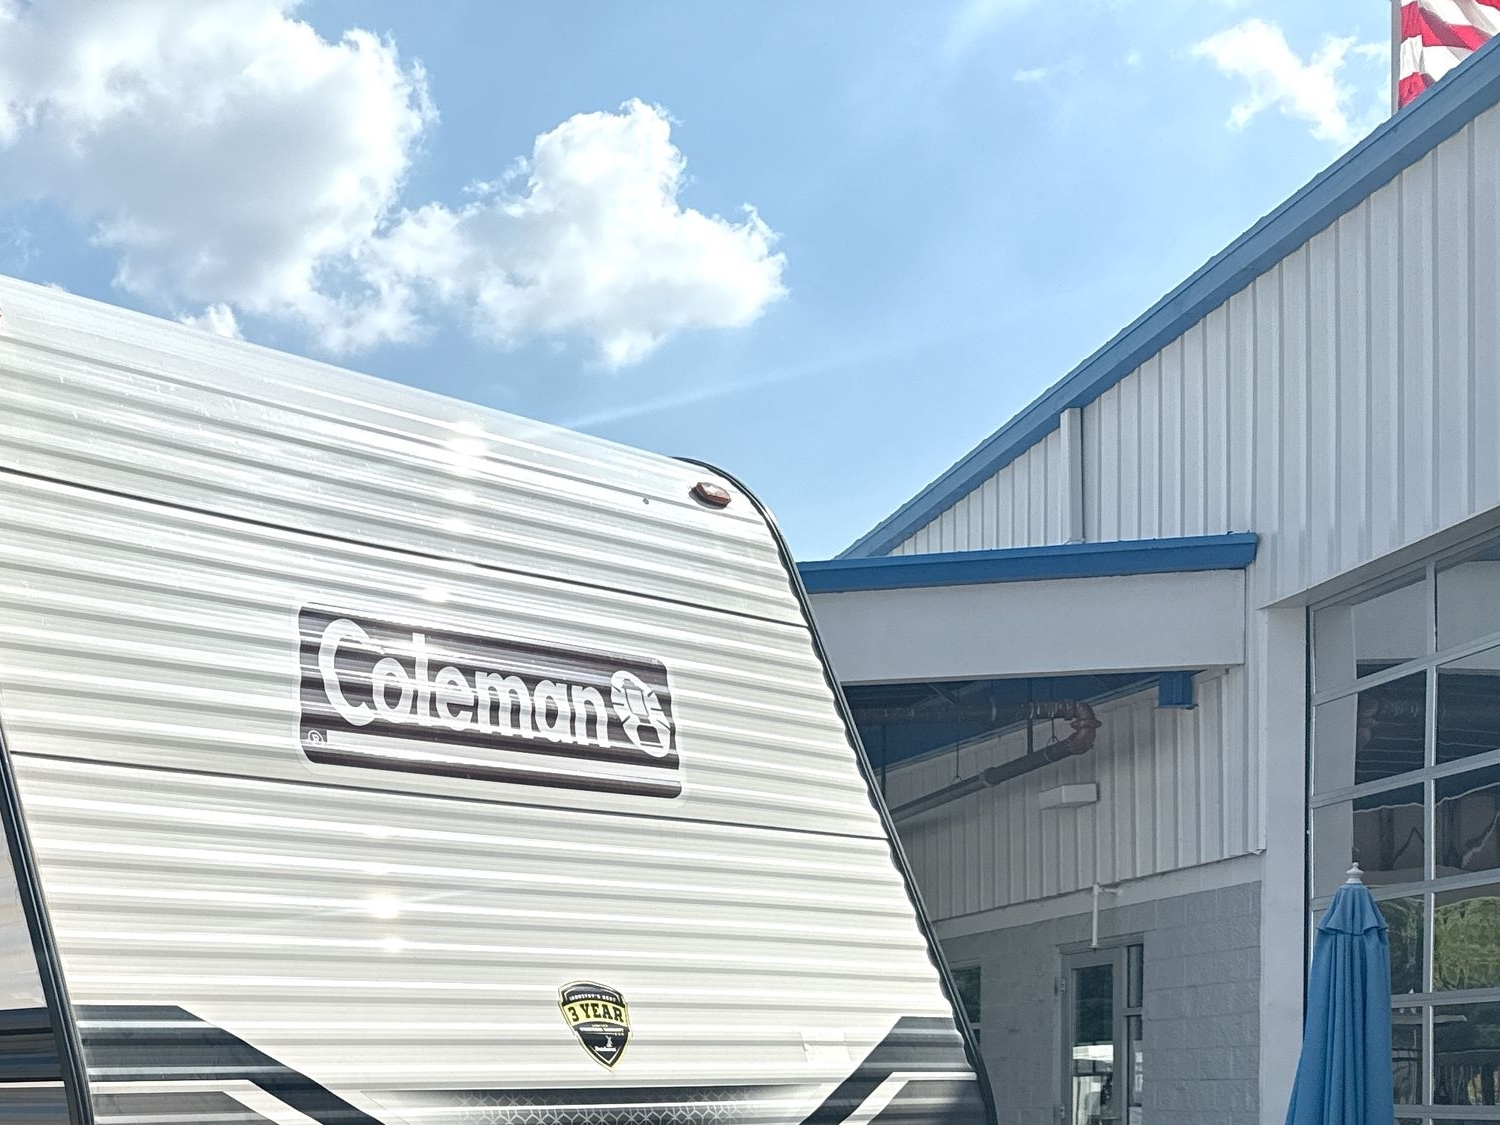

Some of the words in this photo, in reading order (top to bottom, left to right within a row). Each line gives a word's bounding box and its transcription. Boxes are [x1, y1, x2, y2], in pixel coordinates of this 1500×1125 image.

[318, 618, 611, 749] Coleman
[567, 1006, 580, 1022] 3
[579, 1002, 624, 1023] YEAR
